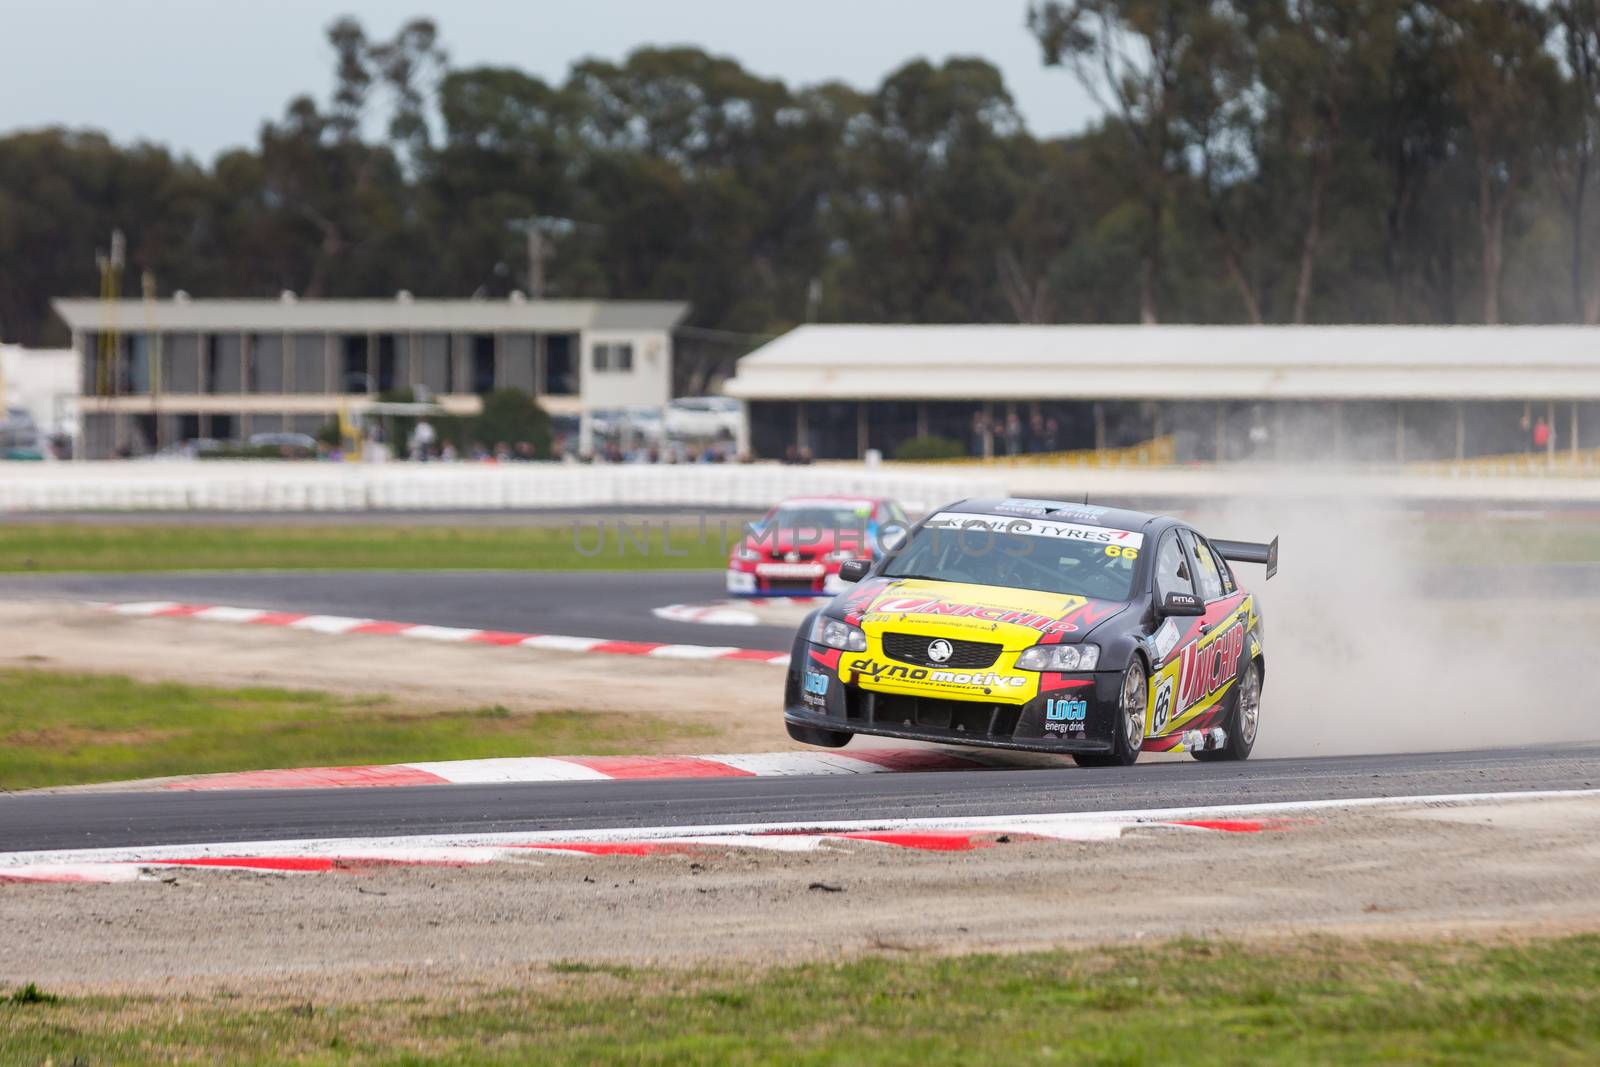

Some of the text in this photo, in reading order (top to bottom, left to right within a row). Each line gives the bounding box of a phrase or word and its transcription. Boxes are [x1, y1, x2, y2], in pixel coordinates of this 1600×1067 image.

[1039, 526, 1112, 542] TYRES
[1104, 545, 1138, 560] 66
[1171, 621, 1244, 719] UNICHIP
[1045, 698, 1087, 721] LOCO
[1153, 684, 1171, 732] 66
[1044, 721, 1086, 733] energy drink
